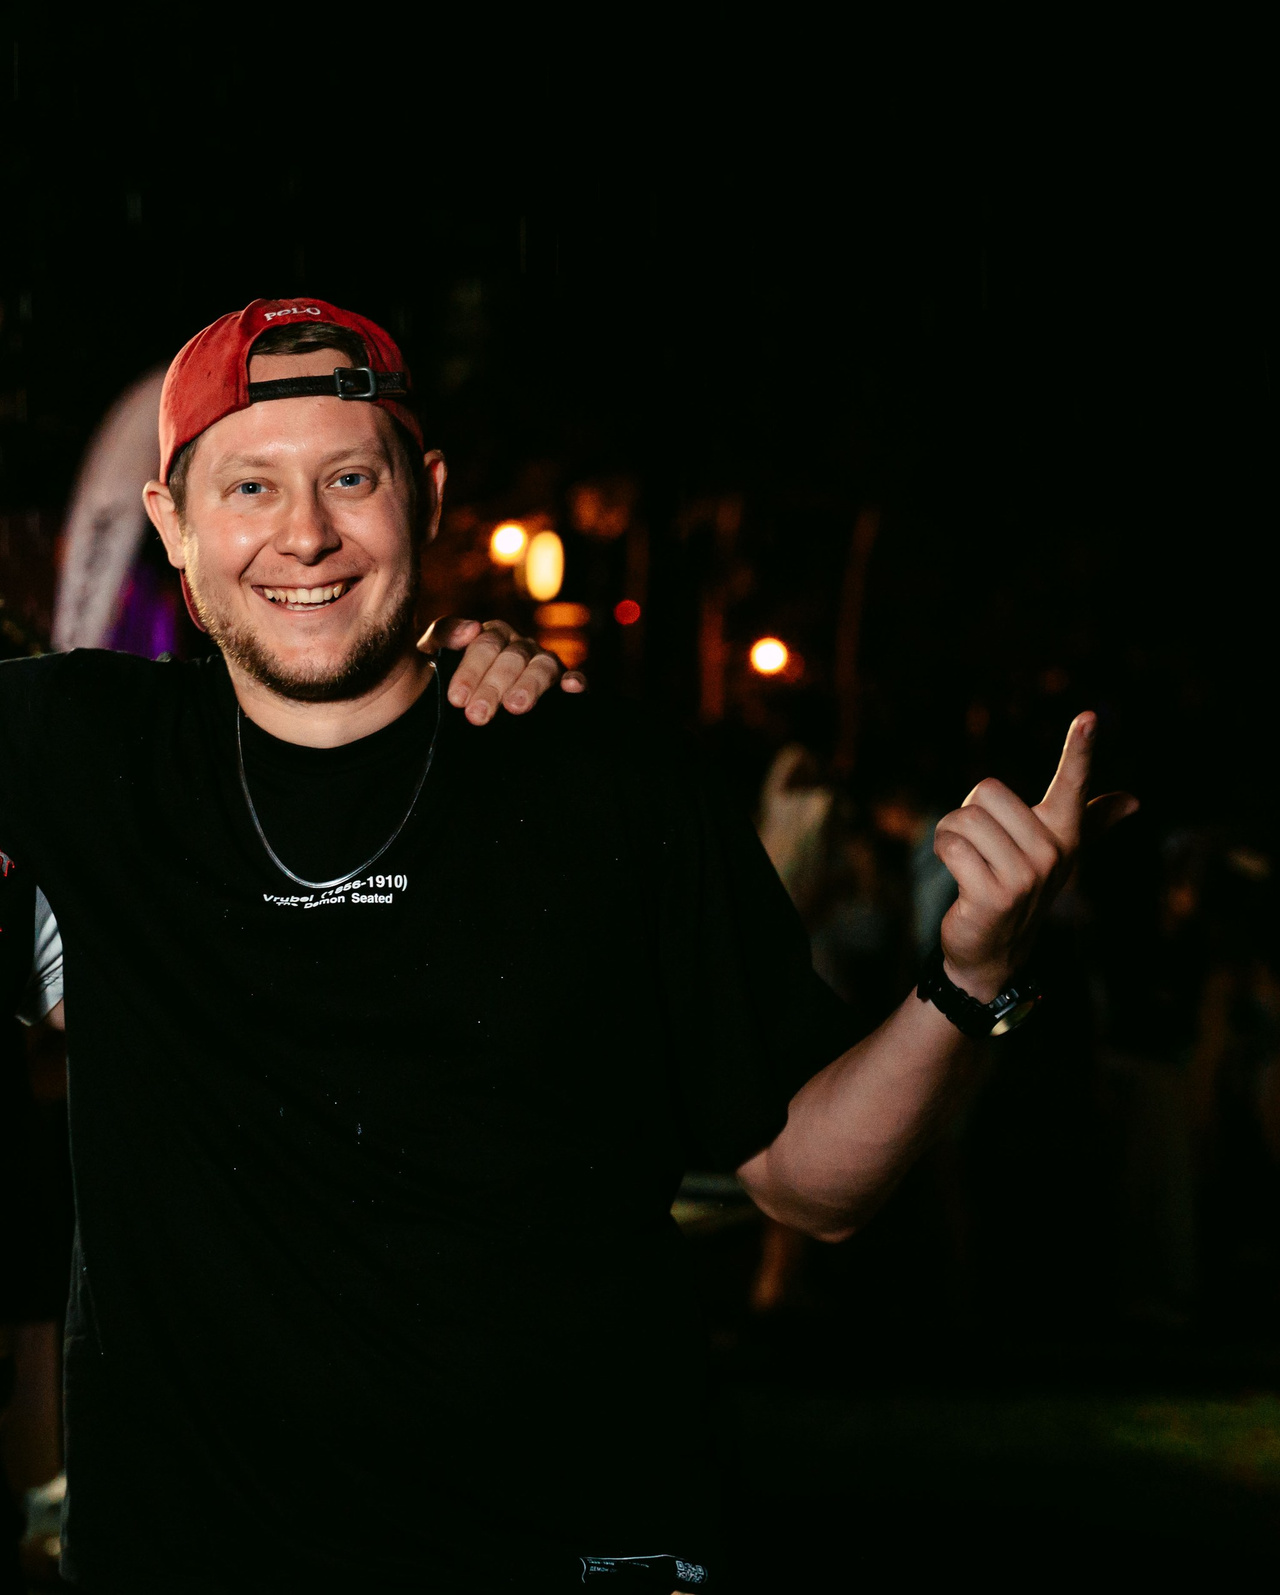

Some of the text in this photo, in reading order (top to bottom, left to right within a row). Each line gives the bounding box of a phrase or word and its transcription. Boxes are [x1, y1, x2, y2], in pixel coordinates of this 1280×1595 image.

[264, 307, 321, 321] POLO
[263, 893, 314, 903] Vrubel
[303, 895, 346, 909] Demon
[351, 892, 393, 904] Seated
